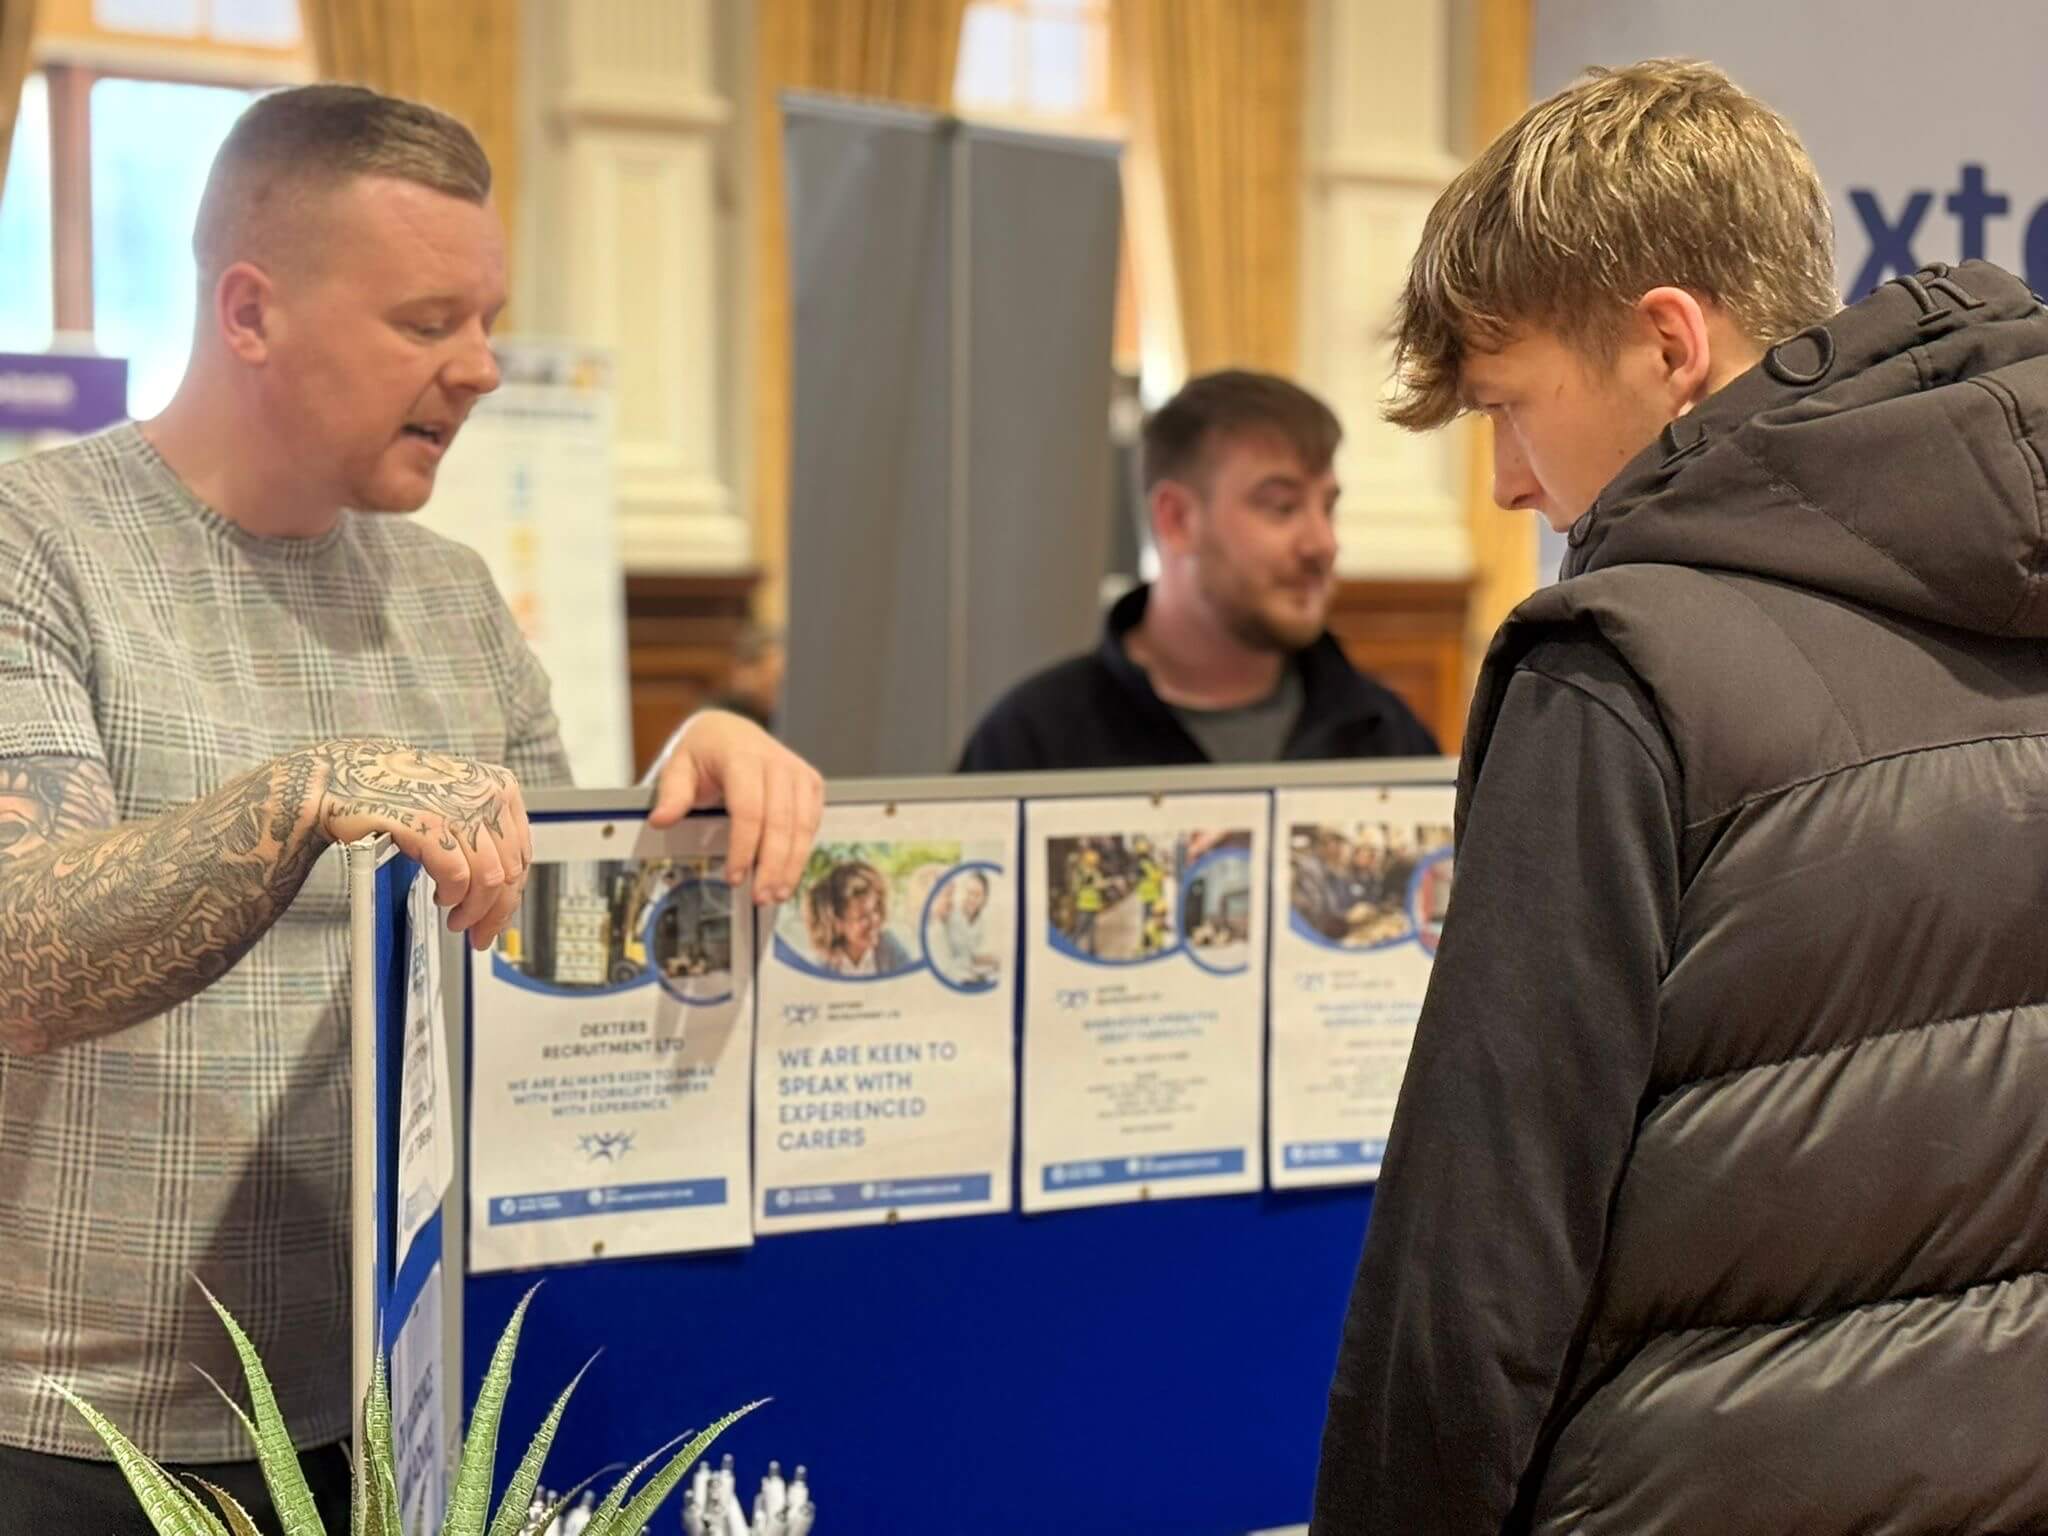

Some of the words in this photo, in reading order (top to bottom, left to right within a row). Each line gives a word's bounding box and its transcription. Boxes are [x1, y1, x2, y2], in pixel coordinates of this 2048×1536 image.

[580, 1020, 648, 1038] DEXTERS
[542, 1040, 651, 1060] RECRUITMENT
[778, 1047, 812, 1069] WE
[820, 1045, 861, 1067] ARE
[868, 1042, 922, 1064] KEEN
[928, 1041, 958, 1061] TO
[508, 1079, 529, 1092] WE
[533, 1077, 556, 1090] ARE
[559, 1072, 615, 1088] ALWAYS
[778, 1075, 849, 1097] SPEAK
[855, 1071, 912, 1092] WITH
[778, 1097, 927, 1125] EXPERIENCED
[777, 1127, 866, 1151] CARERS
